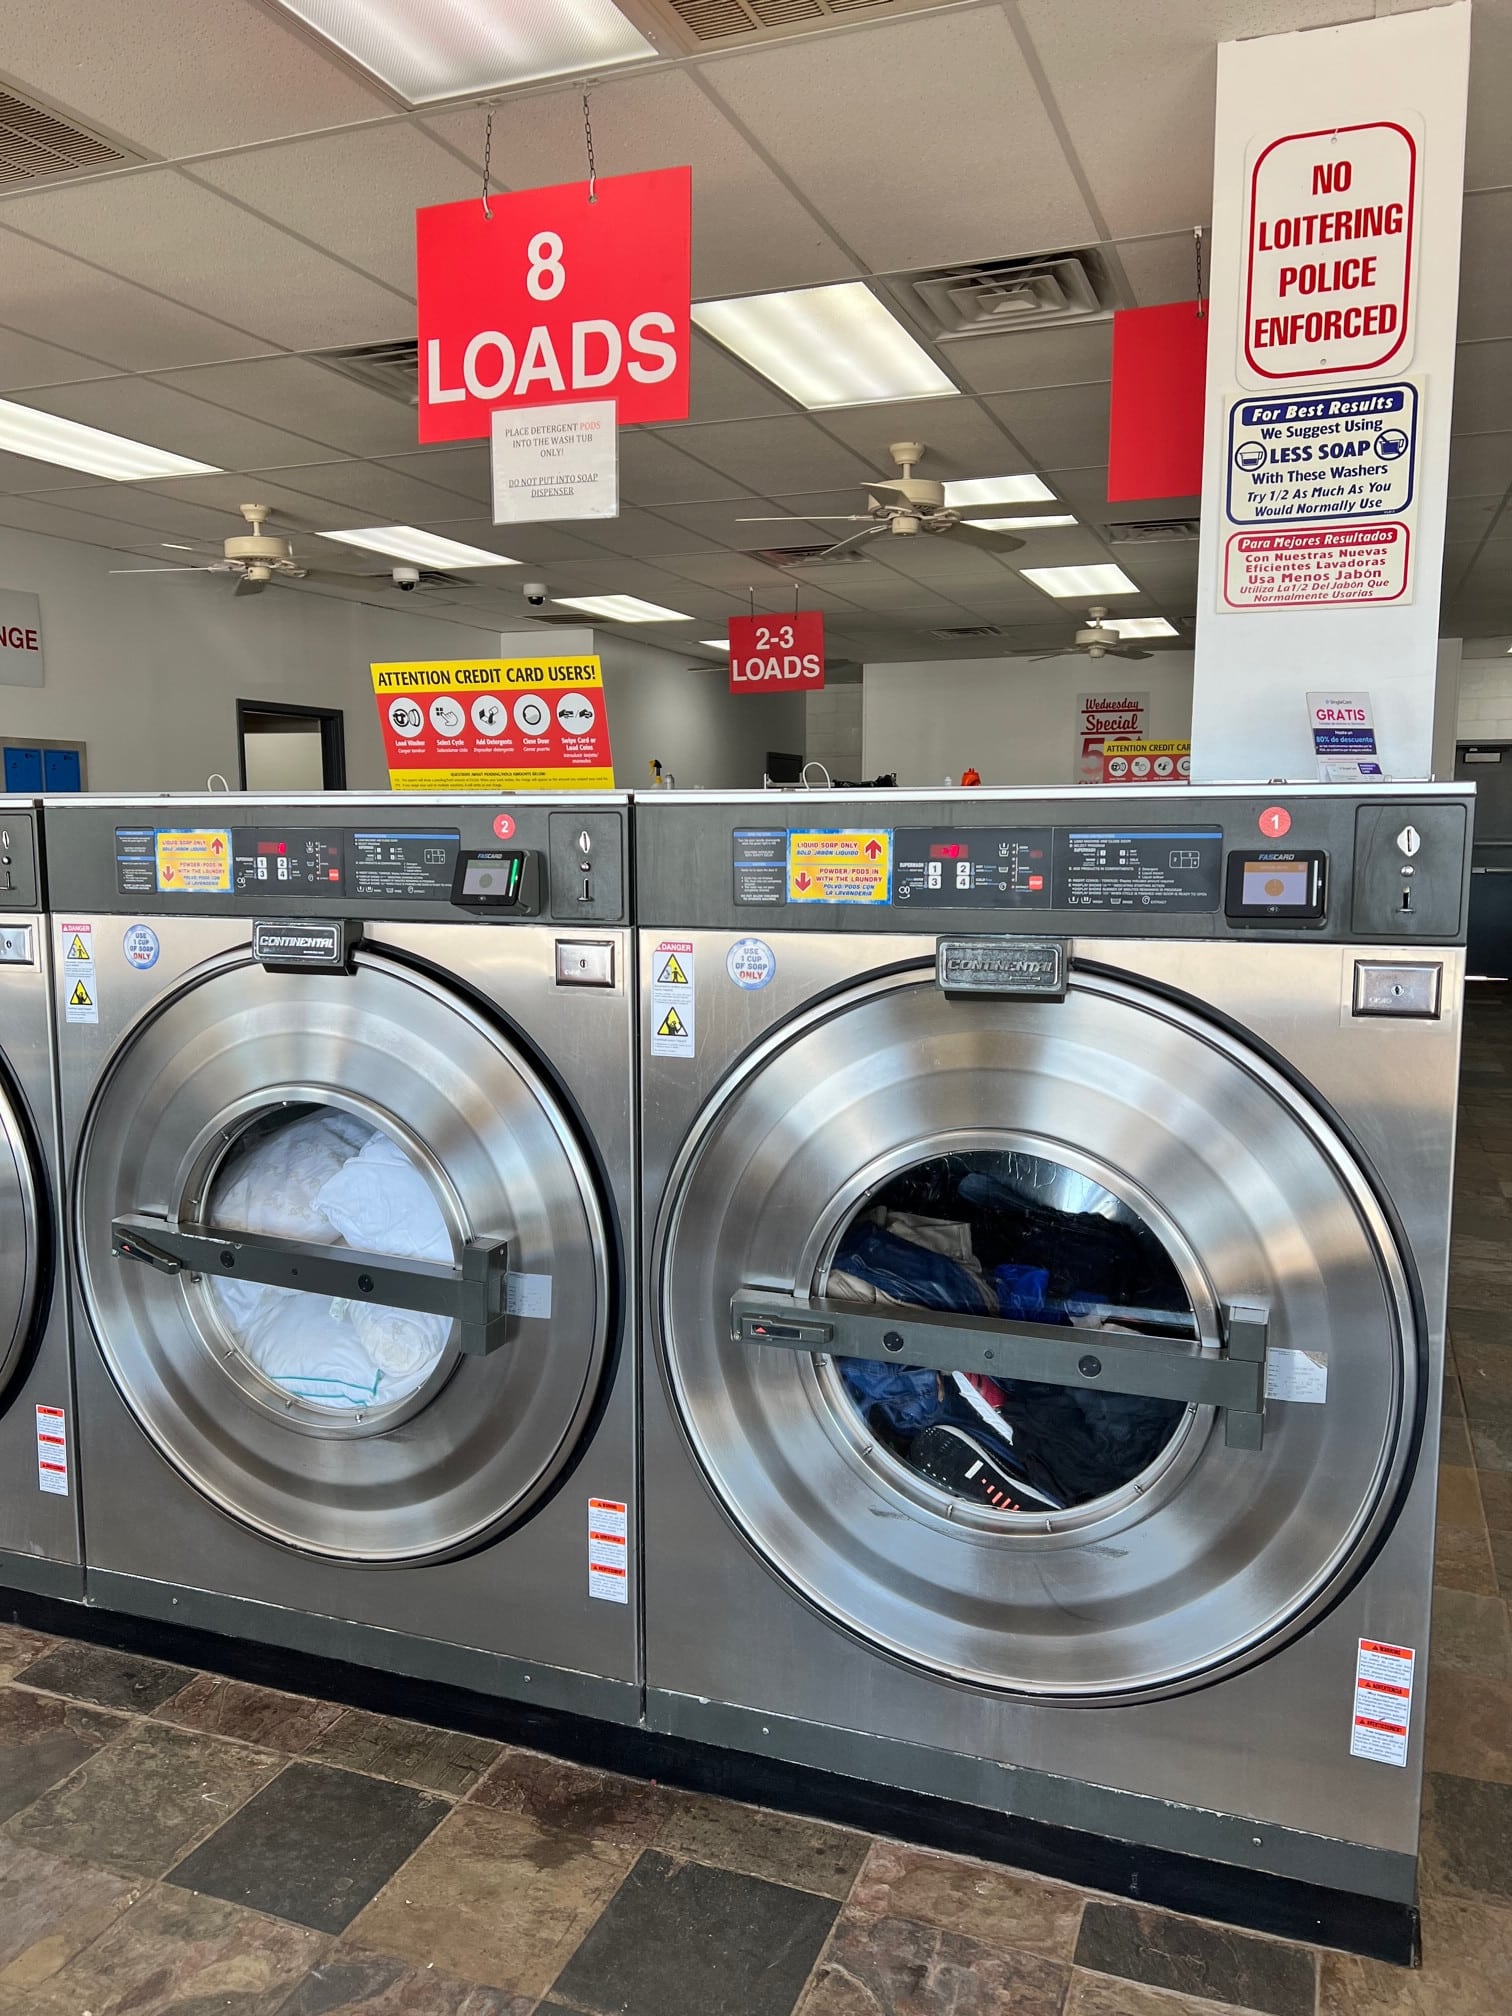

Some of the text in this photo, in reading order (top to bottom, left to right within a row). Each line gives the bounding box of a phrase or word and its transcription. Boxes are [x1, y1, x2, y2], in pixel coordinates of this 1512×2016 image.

[1312, 160, 1352, 195] NO
[1258, 203, 1403, 252] LOITERING
[526, 232, 566, 301] 8
[1279, 256, 1377, 297] POLICE
[1254, 304, 1397, 348] ENFORCED
[428, 312, 677, 404] LOADS
[1252, 396, 1394, 422] For Best Results
[506, 421, 600, 437] PLACE DETERGENT PODS
[1261, 420, 1382, 440] We Suggest Using
[513, 434, 592, 448] INTO THE WASH TUB
[540, 448, 564, 457] ONLY!
[1270, 440, 1370, 464] LESS SOAP
[509, 473, 598, 488] DO NOT PUT INTO SOAP
[1252, 464, 1388, 485] With These Washers
[531, 486, 574, 498] DISPENSER
[1248, 482, 1391, 504] Try 1/2 As Much As You
[1255, 498, 1382, 517] Would Normally Use
[1242, 531, 1393, 550] Para Mejores Resultados
[1245, 548, 1388, 562] Con Nuestras Nuevas
[1246, 558, 1386, 573] Eficientes Lavadoras
[1248, 568, 1382, 584] Usa Menos Jabón
[1240, 585, 1274, 594] Utiliza
[1368, 579, 1390, 588] Que
[1254, 592, 1328, 602] Normalmente
[755, 626, 794, 650] 2-3
[378, 665, 596, 686] ATTENTION CREDIT CARD USERS!
[732, 654, 820, 681] LOADS
[1086, 698, 1138, 710] Wednesday
[1316, 709, 1366, 720] GRATIS
[1086, 714, 1138, 733] Special
[1107, 744, 1146, 752] ATTENTION
[1149, 744, 1174, 752] CREDIT
[500, 820, 508, 832] 2
[1271, 814, 1278, 830] 1
[260, 870, 264, 878] 3
[932, 865, 937, 873] 1
[960, 865, 966, 873] 2
[932, 878, 938, 886] 3
[960, 878, 966, 886] 4
[260, 936, 334, 948] CONTINENTAL
[662, 944, 692, 952] DANGER
[948, 959, 1054, 973] CONTINENTAL
[740, 970, 764, 980] ONLY
